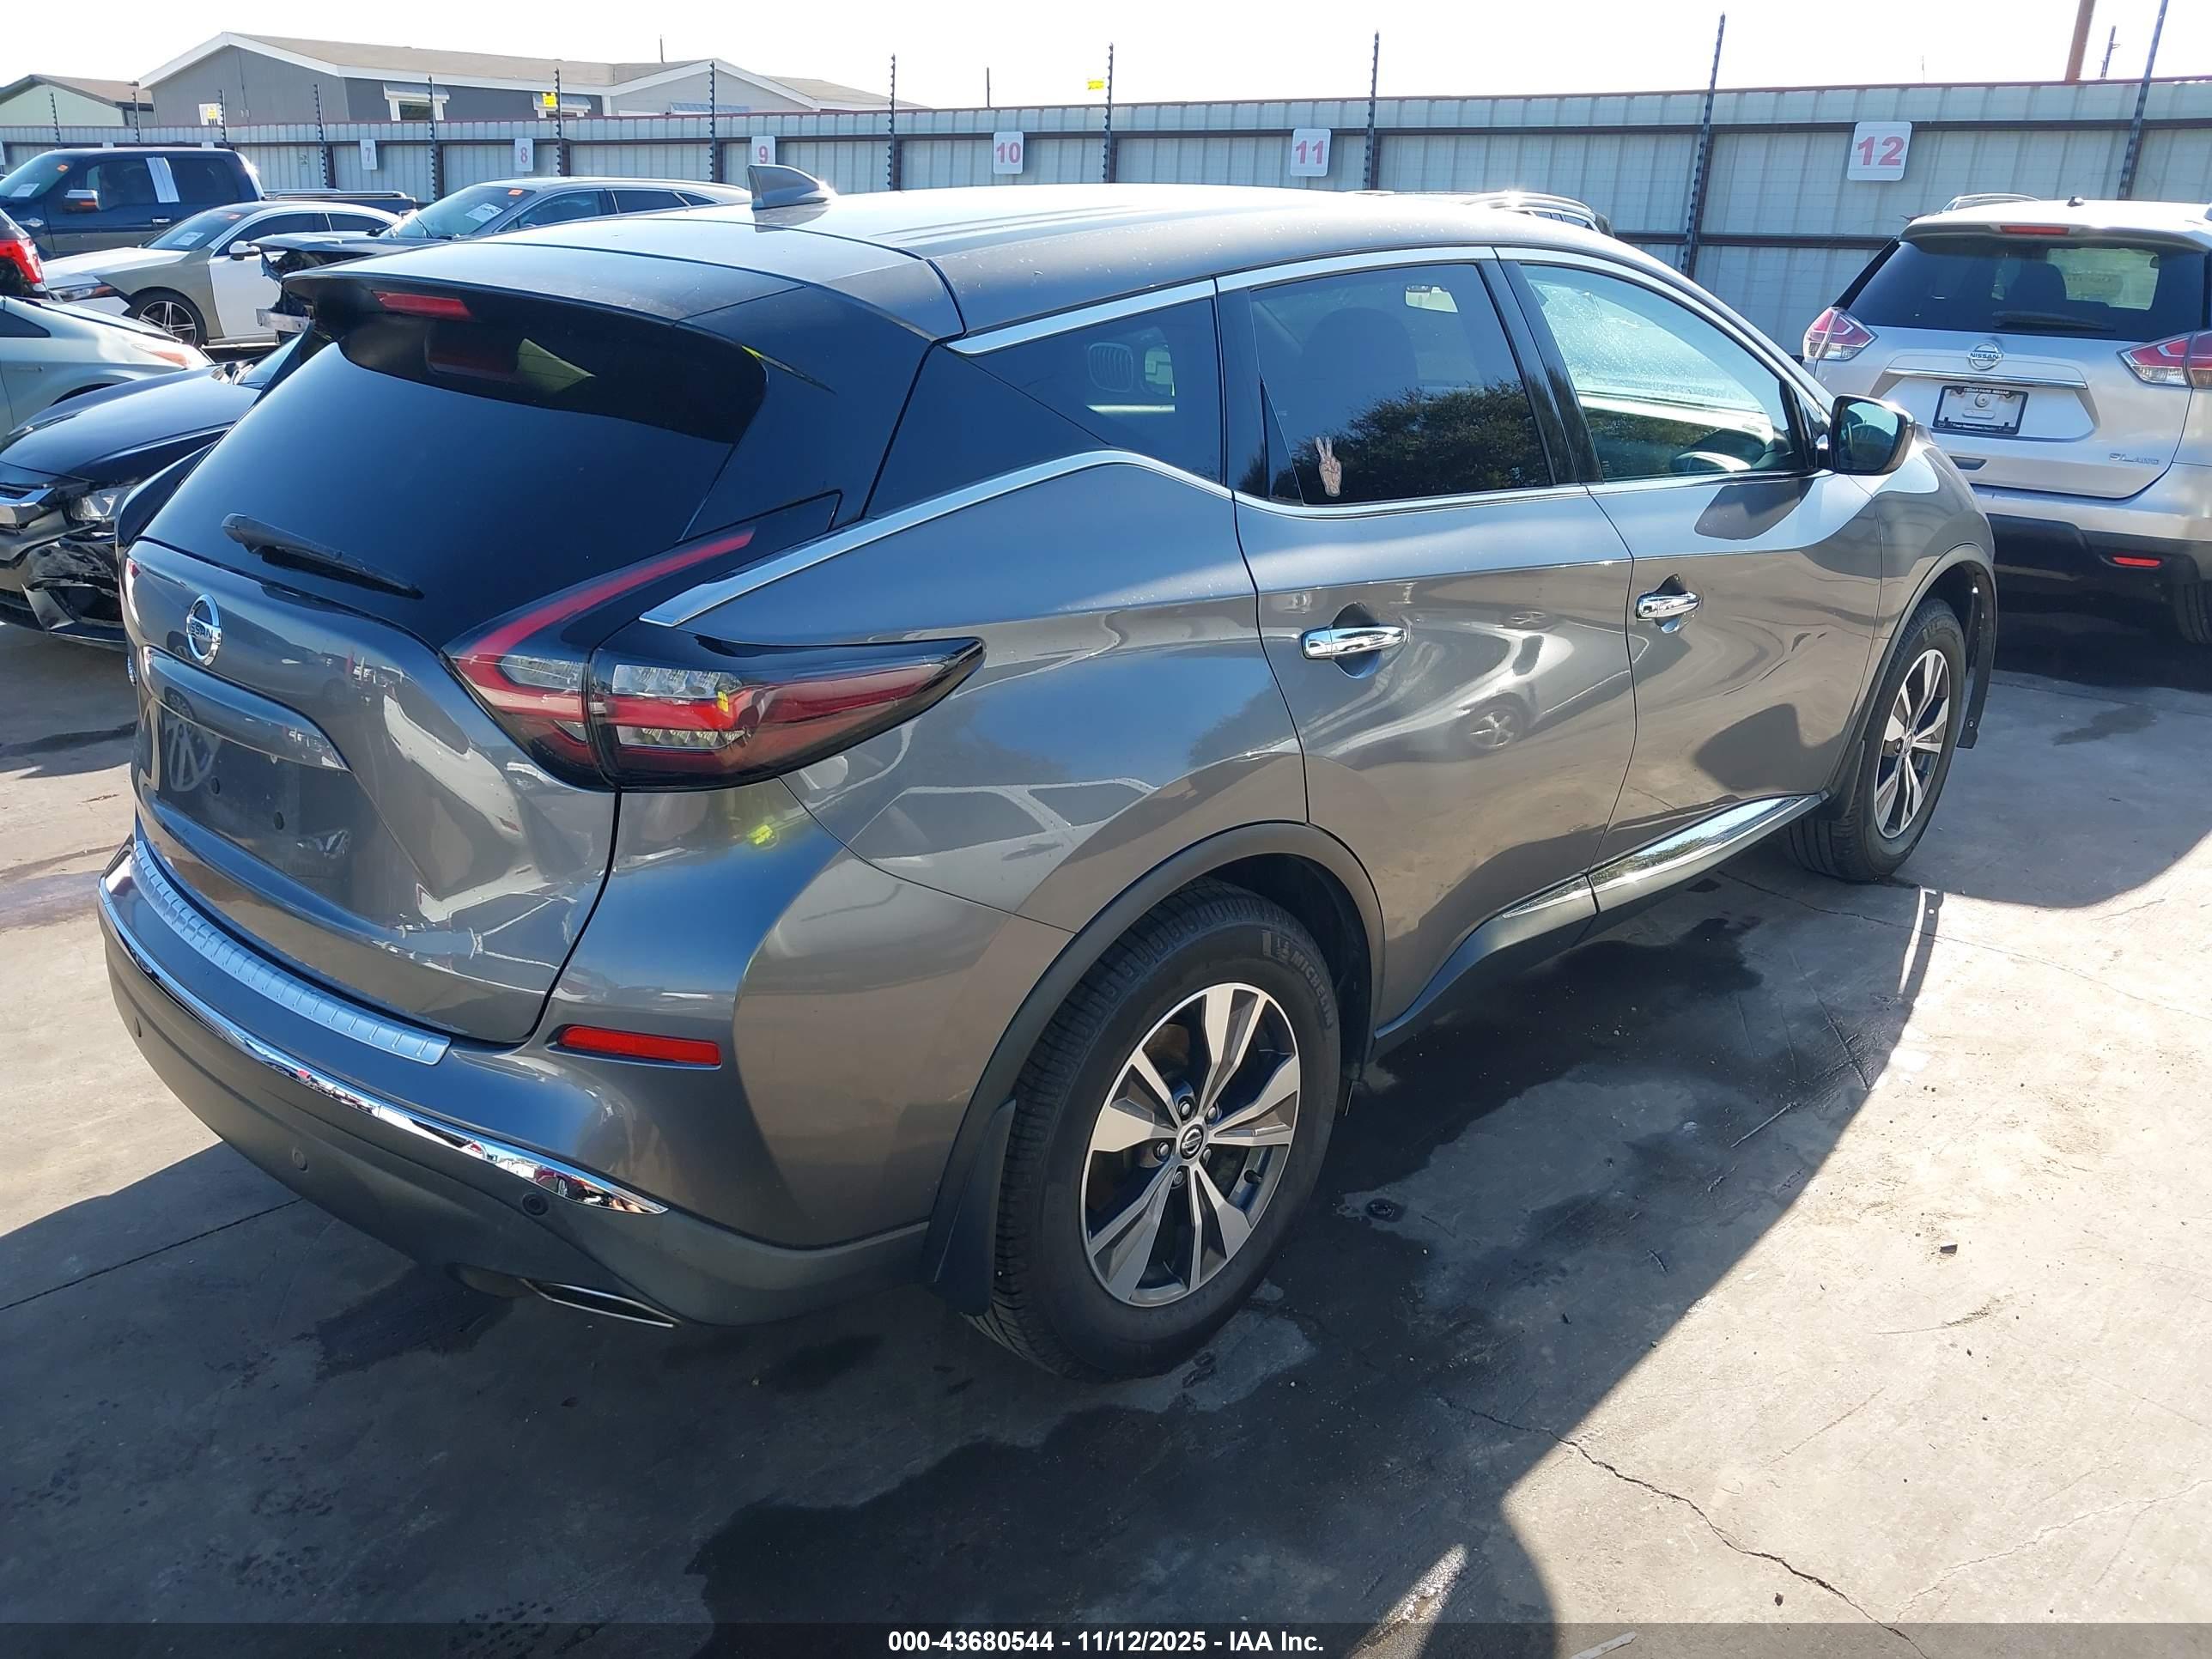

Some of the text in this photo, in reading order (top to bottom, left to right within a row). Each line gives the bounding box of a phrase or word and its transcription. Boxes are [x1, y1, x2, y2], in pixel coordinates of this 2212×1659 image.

[364, 147, 373, 162] 7
[520, 147, 528, 164] 8
[758, 145, 769, 164] 9
[996, 142, 1021, 164] 10
[1295, 140, 1324, 164] 11
[1857, 136, 1905, 166] 12
[1291, 950, 1334, 1030] MICHELIN
